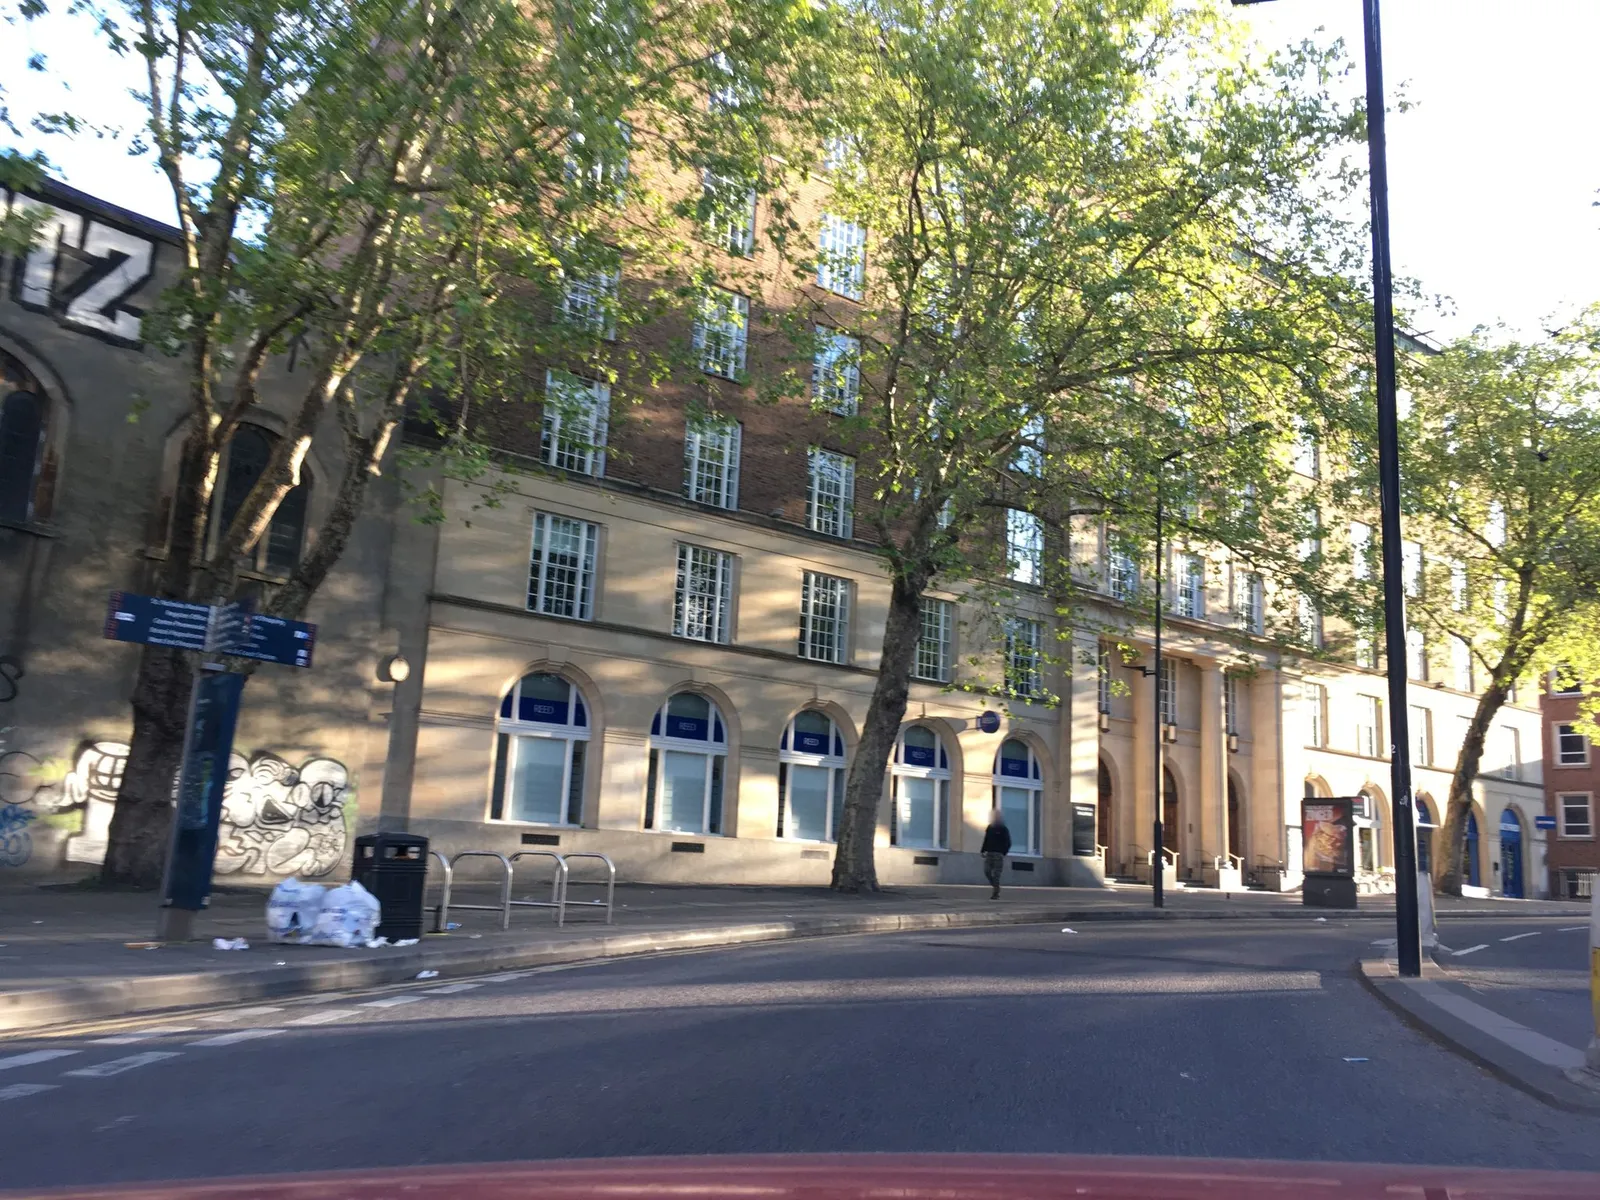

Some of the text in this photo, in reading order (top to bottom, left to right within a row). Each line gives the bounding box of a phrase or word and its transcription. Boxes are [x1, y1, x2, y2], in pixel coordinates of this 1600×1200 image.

[534, 704, 555, 714] REED
[679, 721, 697, 731] REED
[803, 737, 820, 746] REED
